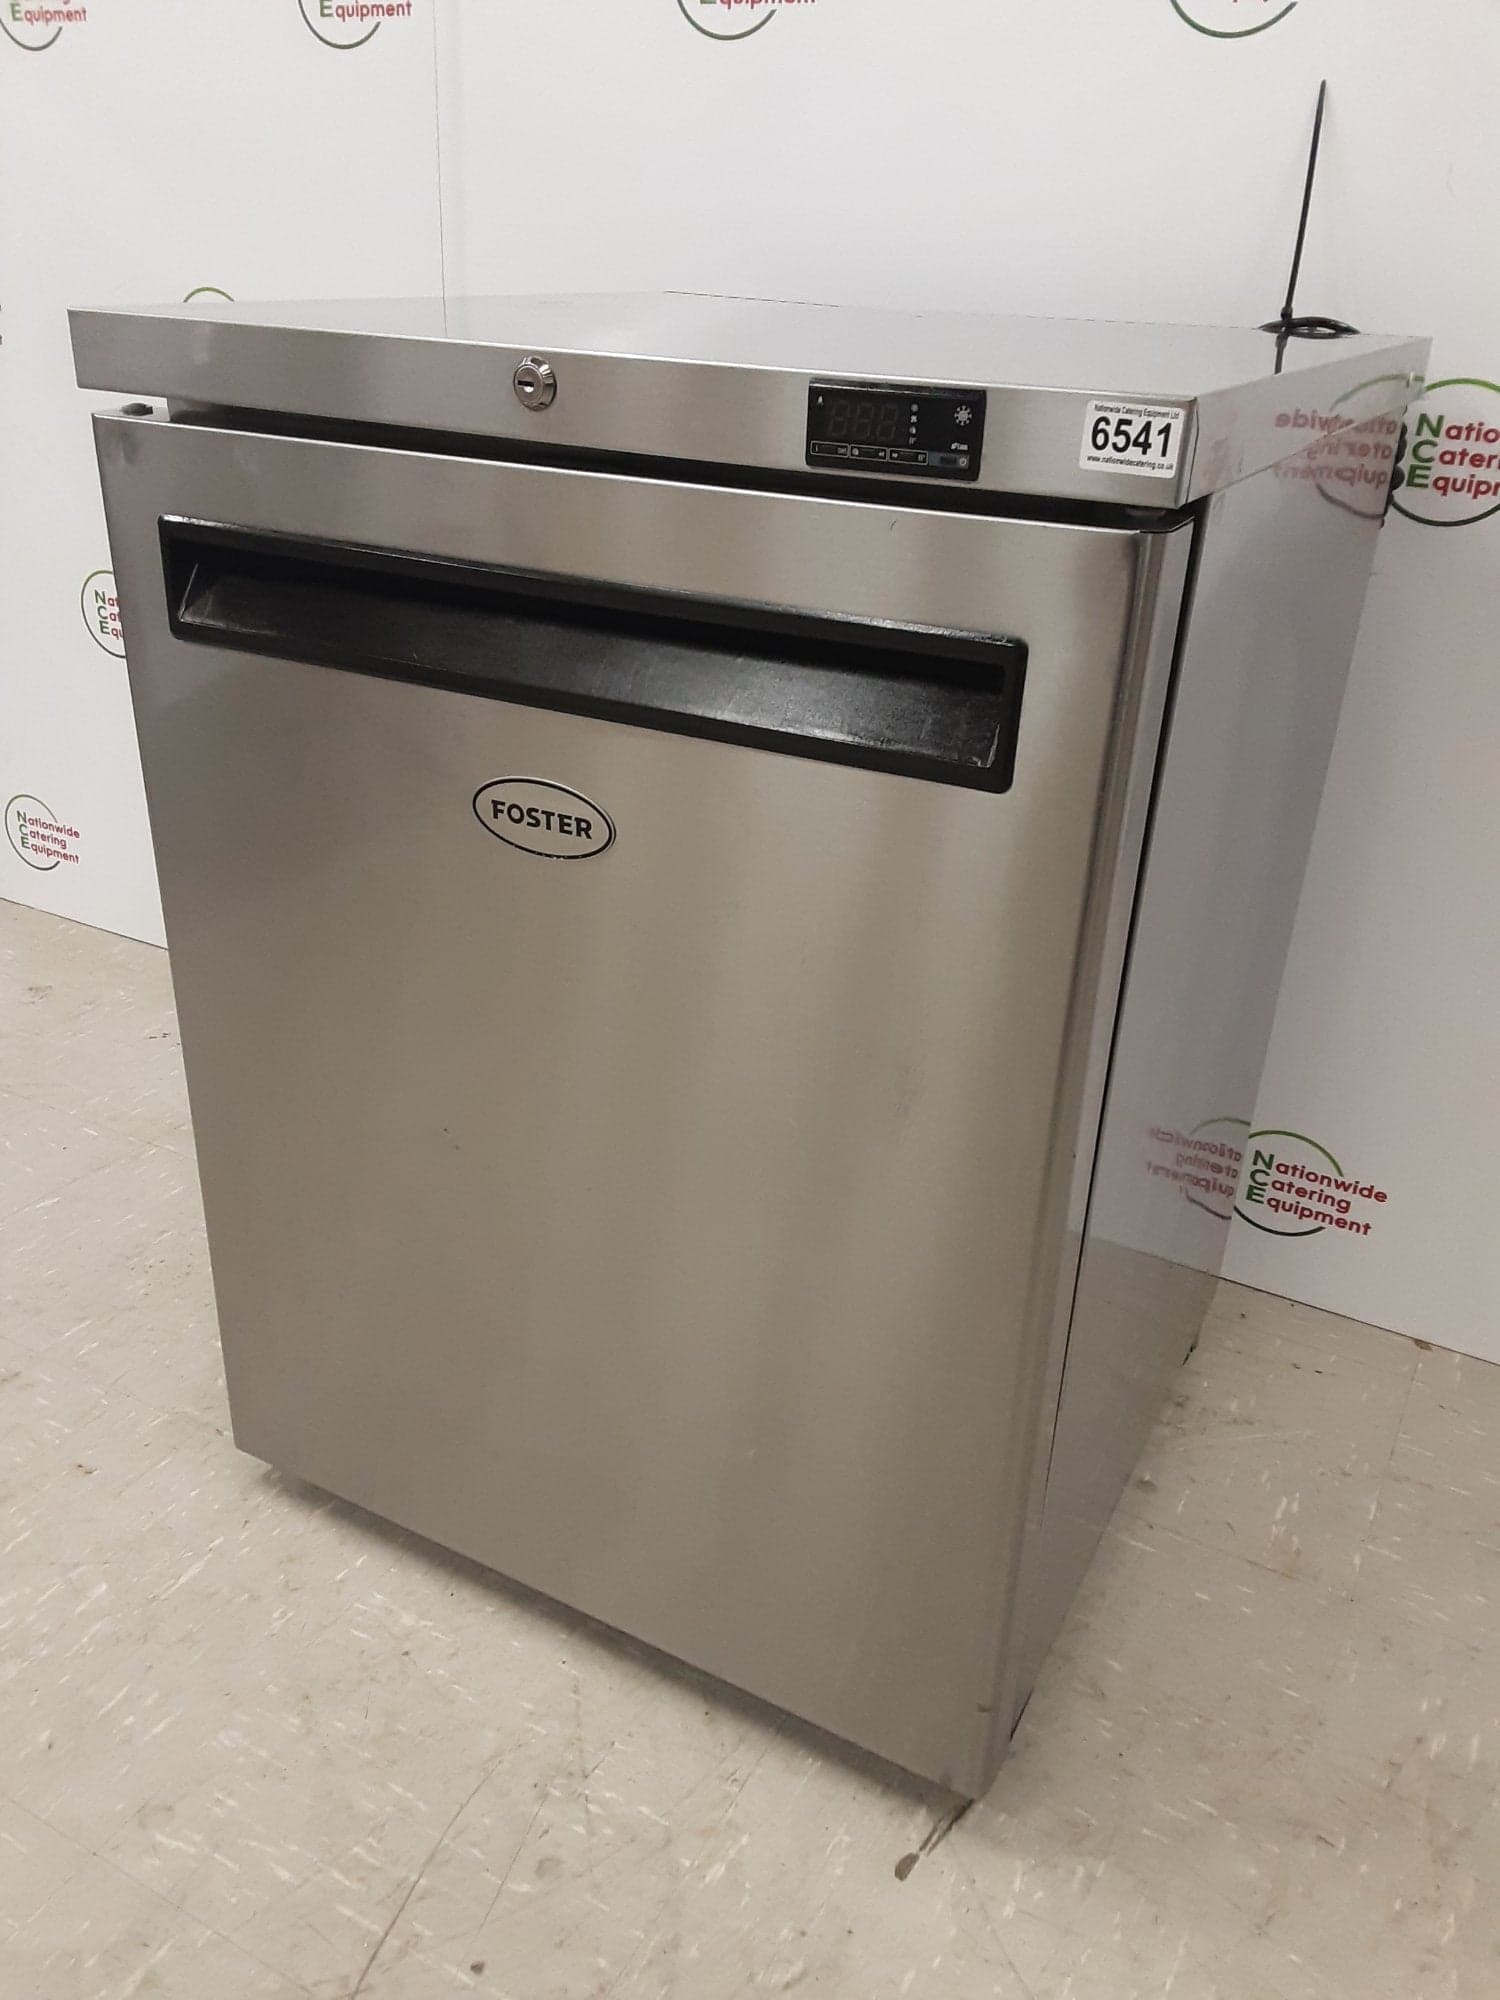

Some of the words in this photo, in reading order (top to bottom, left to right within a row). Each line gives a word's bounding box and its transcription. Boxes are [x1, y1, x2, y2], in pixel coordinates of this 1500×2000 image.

[10, 3, 87, 26] Equipment
[319, 0, 412, 22] Equipment
[1091, 416, 1172, 457] 6541
[16, 810, 80, 838] Nationwide
[19, 824, 67, 849] Catering
[491, 799, 592, 840] FOSTER
[20, 836, 79, 864] Equipment
[1250, 1169, 1351, 1214] Catering
[1252, 1150, 1388, 1203] Nationwide
[1246, 1184, 1372, 1236] Equipment
